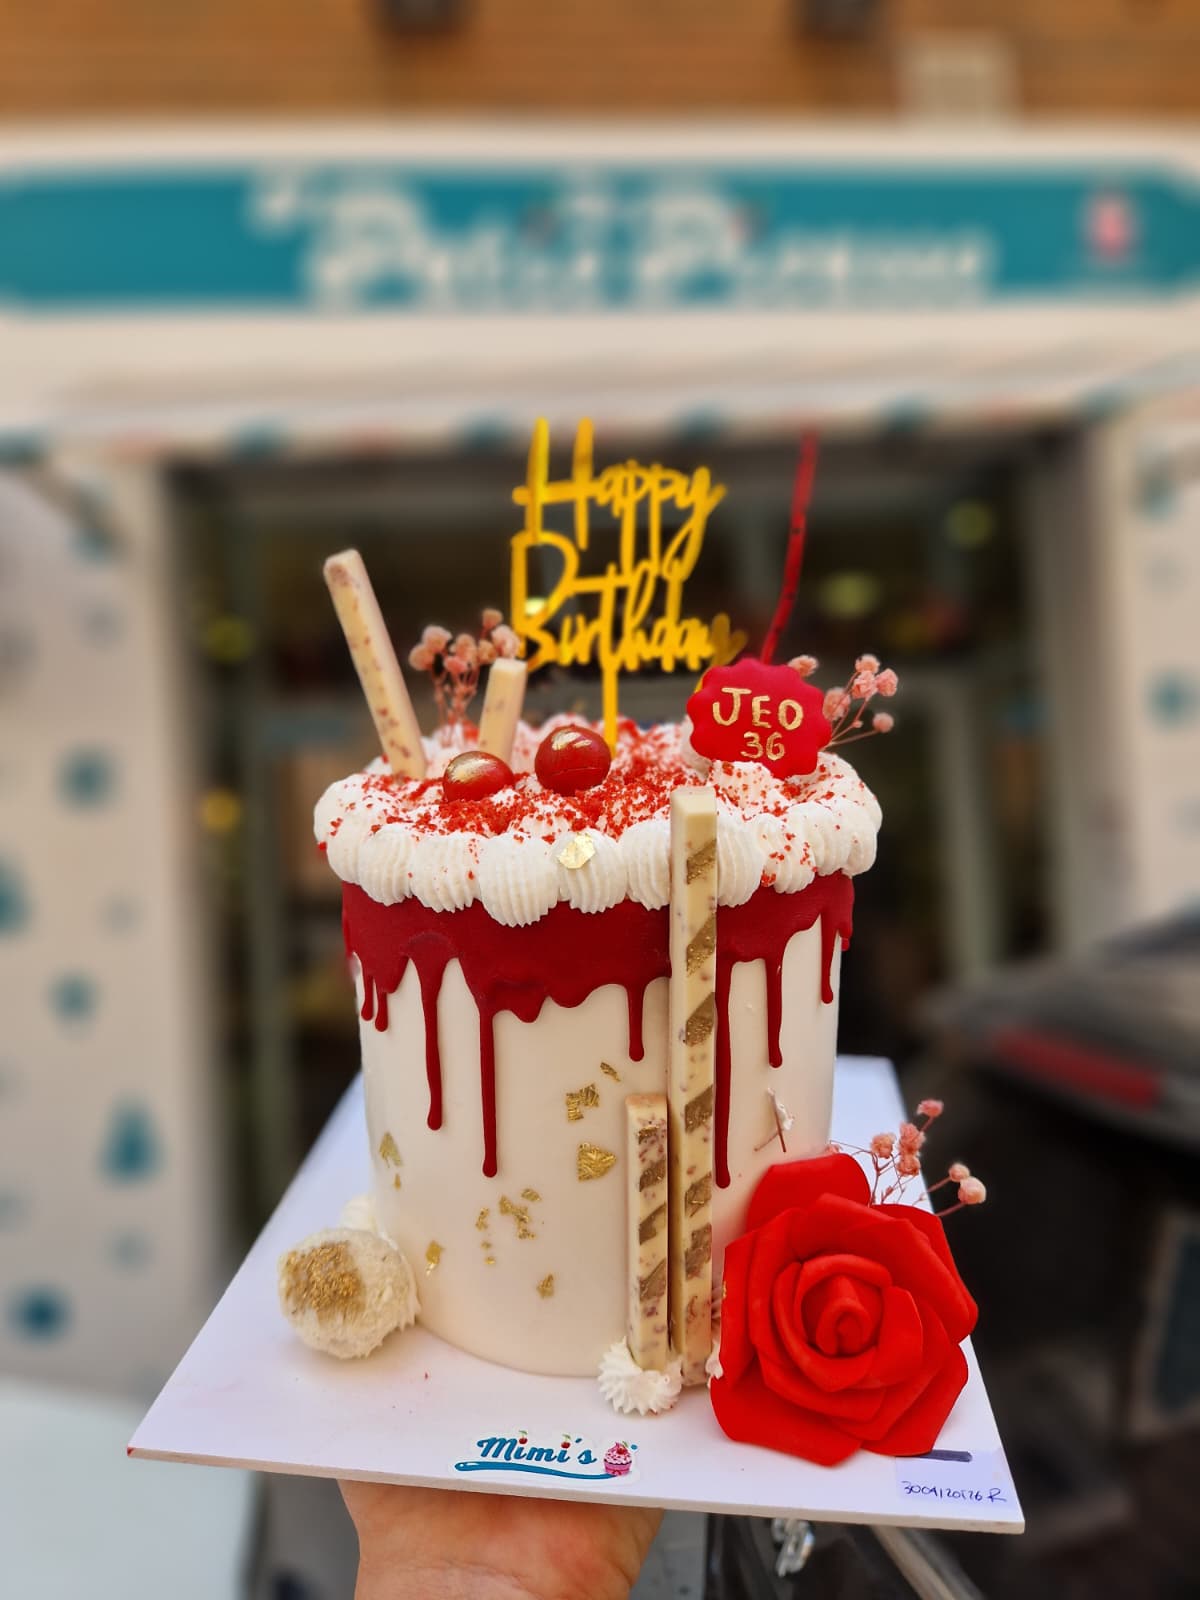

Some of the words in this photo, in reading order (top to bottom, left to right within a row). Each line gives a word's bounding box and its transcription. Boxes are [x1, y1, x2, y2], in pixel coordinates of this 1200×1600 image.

[511, 417, 727, 582] Happy
[510, 531, 747, 673] Birthday
[712, 687, 804, 731] JEO
[740, 731, 786, 761] 36
[476, 1431, 598, 1465] Mimi's
